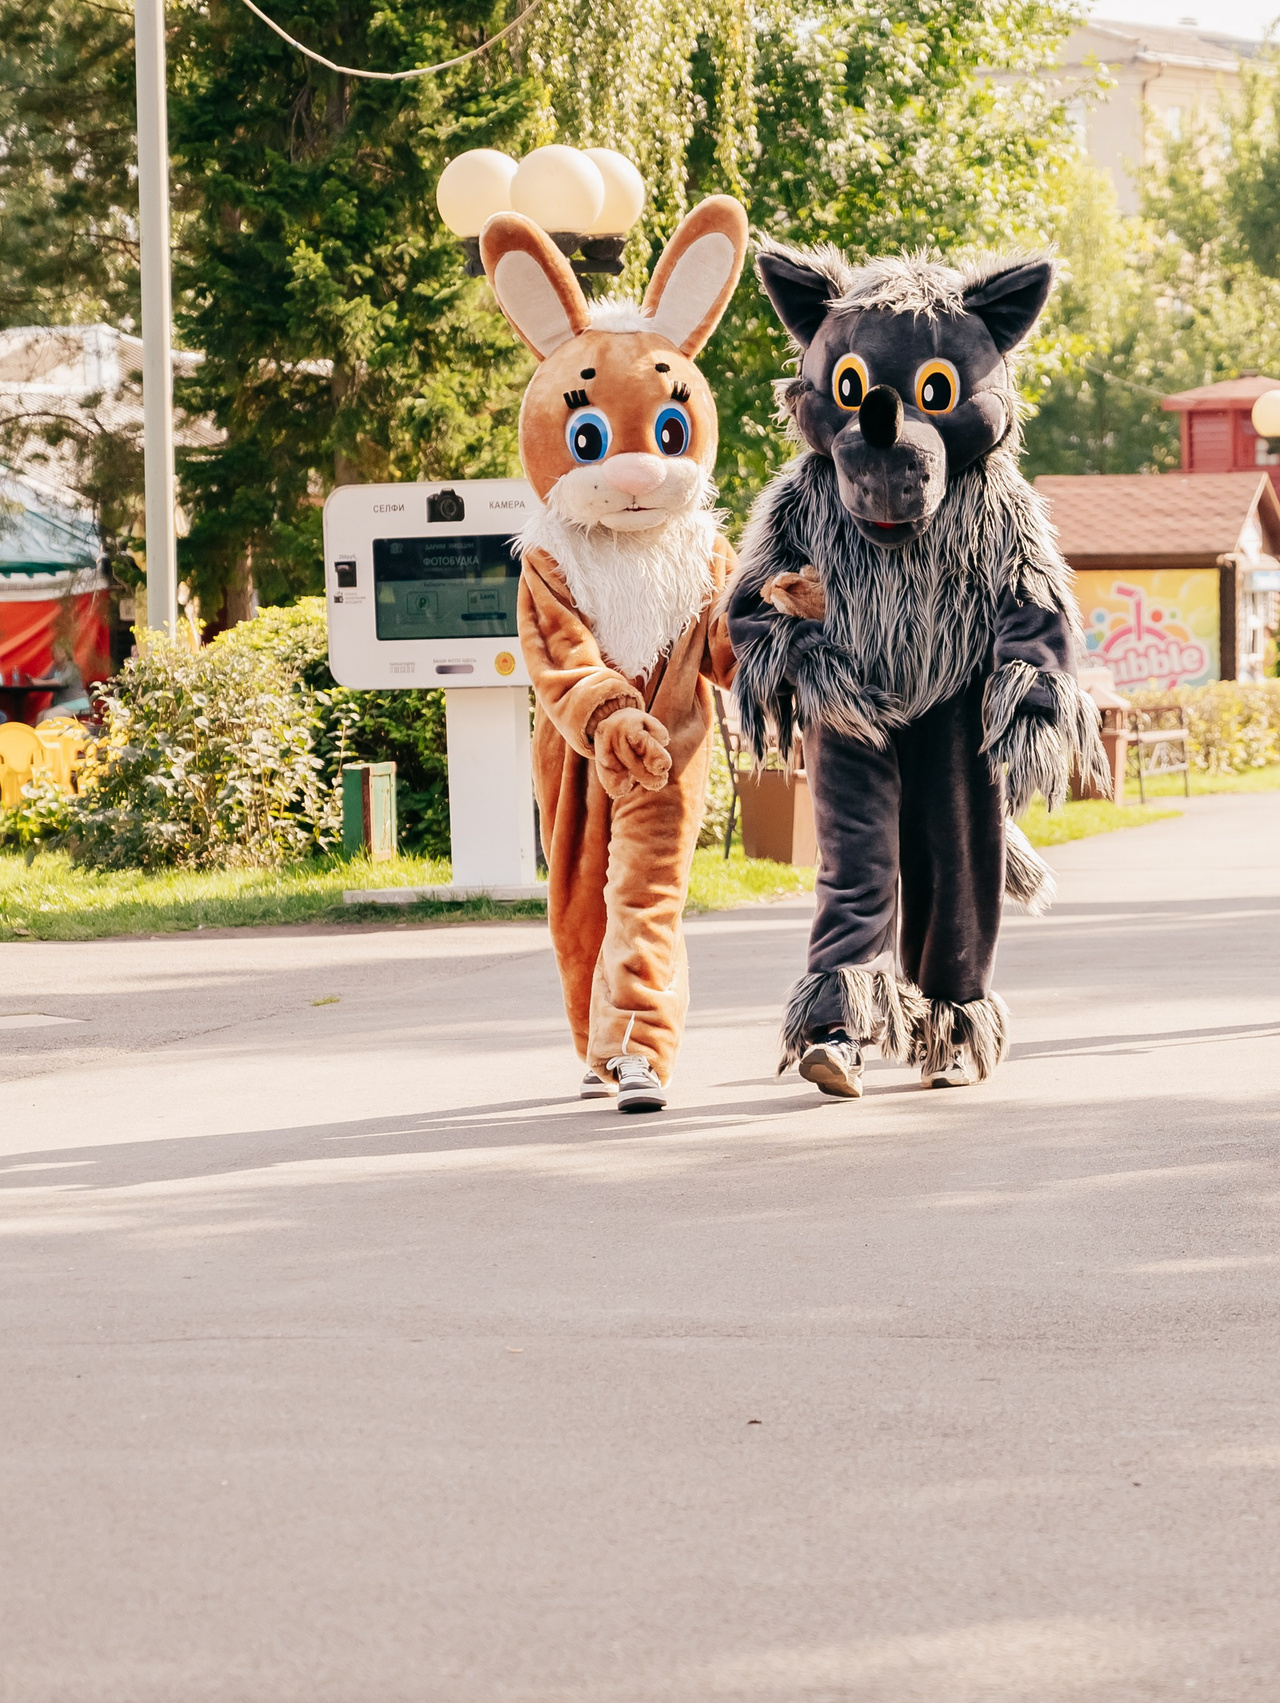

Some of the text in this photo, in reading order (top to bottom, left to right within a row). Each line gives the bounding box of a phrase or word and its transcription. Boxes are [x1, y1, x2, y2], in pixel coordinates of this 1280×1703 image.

[373, 501, 526, 513] СЕЛФИ КАМЕРА
[423, 555, 480, 566] ФОТОБУДКА
[1093, 641, 1204, 687] ubble
